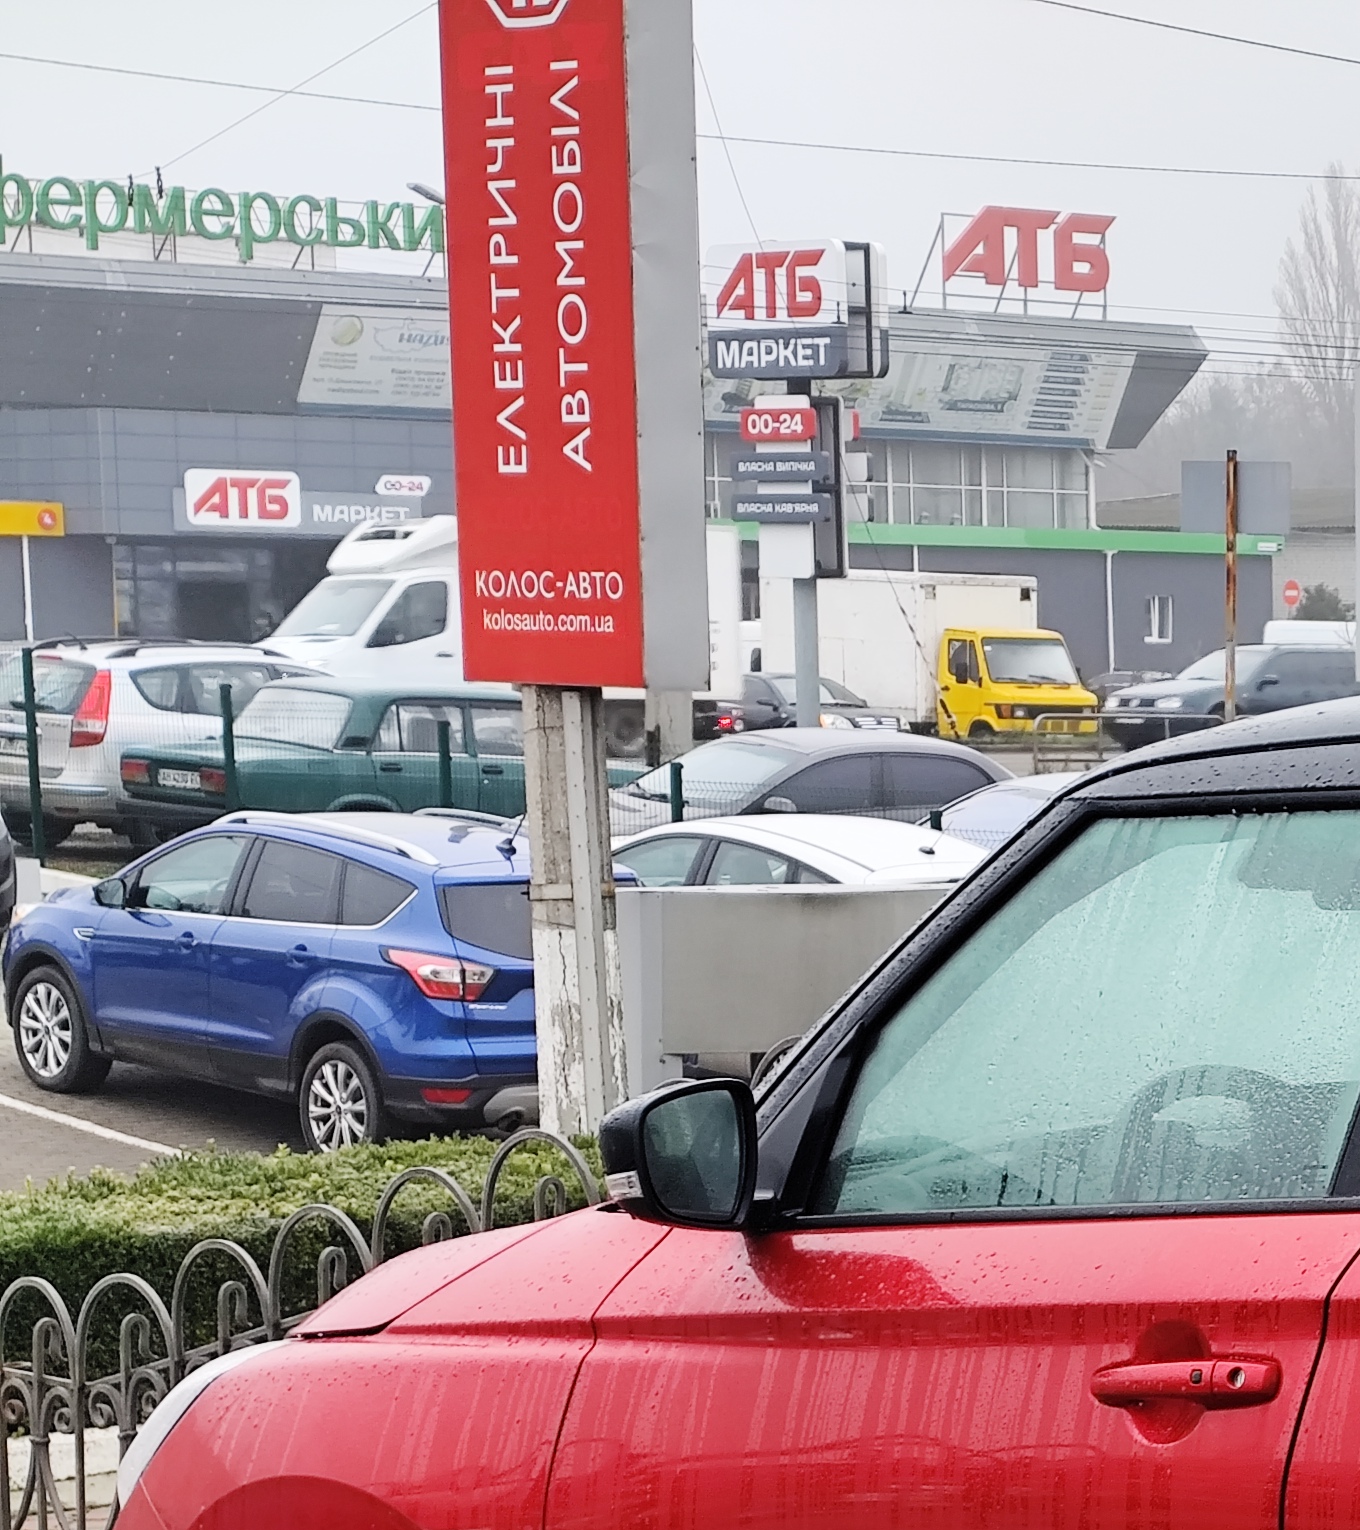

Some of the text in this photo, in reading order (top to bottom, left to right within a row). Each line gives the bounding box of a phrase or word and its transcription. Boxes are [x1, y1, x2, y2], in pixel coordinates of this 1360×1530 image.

[484, 65, 528, 474] ЕЛЕКТРИЧНІ
[549, 59, 592, 472] АВТОМОБІЛІ
[943, 204, 1117, 292] АТБ
[716, 249, 826, 320] АТБ
[716, 336, 831, 369] МАРКЕТ
[747, 413, 804, 435] 00-24
[193, 477, 292, 520] АТБ
[475, 570, 624, 600] КОЛОС-АВТО
[483, 607, 615, 633] kolosauto.com.ua
